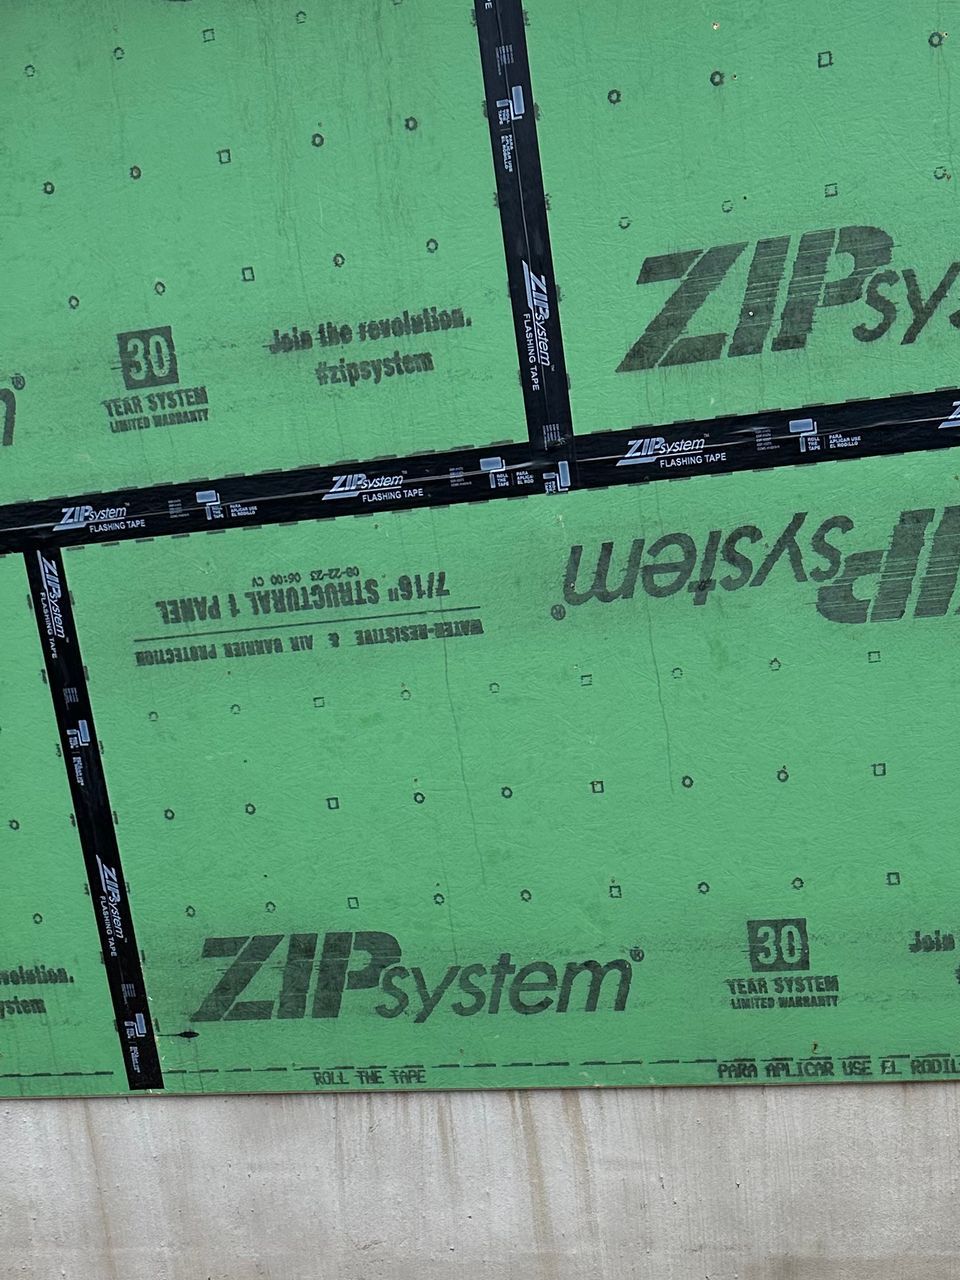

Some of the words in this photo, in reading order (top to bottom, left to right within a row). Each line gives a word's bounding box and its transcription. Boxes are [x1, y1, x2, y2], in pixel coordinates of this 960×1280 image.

[269, 327, 313, 354] Join
[317, 321, 353, 347] the
[357, 306, 472, 341] revolution.
[523, 313, 536, 364] FLASHING
[124, 332, 172, 383] 30
[315, 350, 435, 387] #zipsystem
[529, 365, 540, 391] TAPE
[103, 396, 144, 417] YEAR
[147, 386, 209, 412] SYSTEM
[109, 416, 150, 433] LIMITED
[152, 408, 209, 428] WARRANTY
[624, 436, 706, 458] ZIPsystem
[660, 455, 703, 468] FLASHING
[704, 452, 726, 463] TAPE
[362, 490, 402, 503] FLASHING
[403, 488, 424, 498] TAPE
[89, 521, 125, 533] FLASHING
[126, 519, 146, 530] TAPE
[156, 594, 222, 625] PANEL
[228, 593, 242, 619] 1
[246, 578, 380, 616] STRUCTURAL
[39, 591, 54, 636] FLASHING
[48, 636, 58, 659] TAPE
[224, 637, 284, 658] BARRIER
[290, 634, 314, 652] AIR
[328, 632, 340, 648] &
[100, 896, 112, 936] FLASHING
[106, 936, 118, 958] TAPE
[753, 924, 803, 967] 30
[909, 931, 955, 953] Join
[189, 930, 632, 1024] ZIPsystem
[726, 978, 768, 996] YEAR
[773, 974, 840, 994] SYSTEM
[731, 997, 776, 1010] LIMITED
[778, 995, 838, 1010] WARRANTY
[313, 1070, 350, 1086] ROLL
[356, 1070, 384, 1086] THE
[391, 1068, 427, 1085] TAPE
[717, 1060, 758, 1080] PARA
[765, 1062, 834, 1078] APLICAR
[842, 1061, 872, 1076] USE
[880, 1060, 902, 1076] EL
